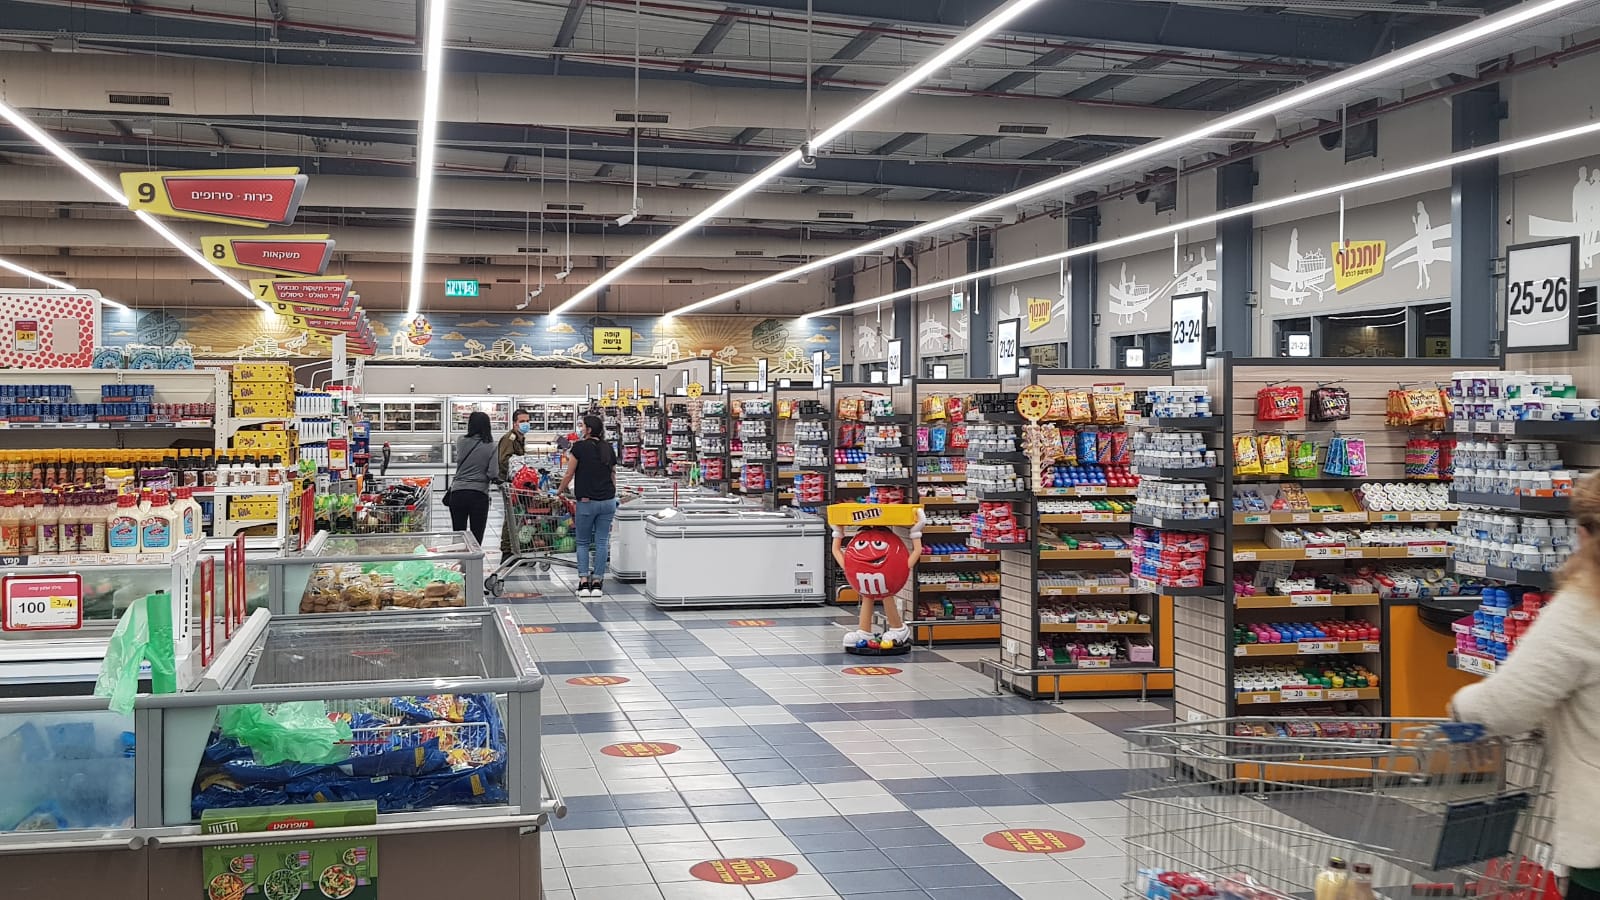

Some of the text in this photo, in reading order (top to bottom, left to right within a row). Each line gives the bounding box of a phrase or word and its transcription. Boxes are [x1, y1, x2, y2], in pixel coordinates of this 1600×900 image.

[138, 183, 156, 203] 9
[191, 191, 273, 202] בירות סירופים
[212, 244, 226, 259] 8
[262, 250, 301, 260] משקאות
[258, 285, 269, 297] 7
[1510, 277, 1568, 316] 25-26
[1173, 320, 1200, 344] 23-24
[999, 339, 1015, 358] 21-22
[856, 572, 888, 595] m
[18, 602, 46, 614] 100
